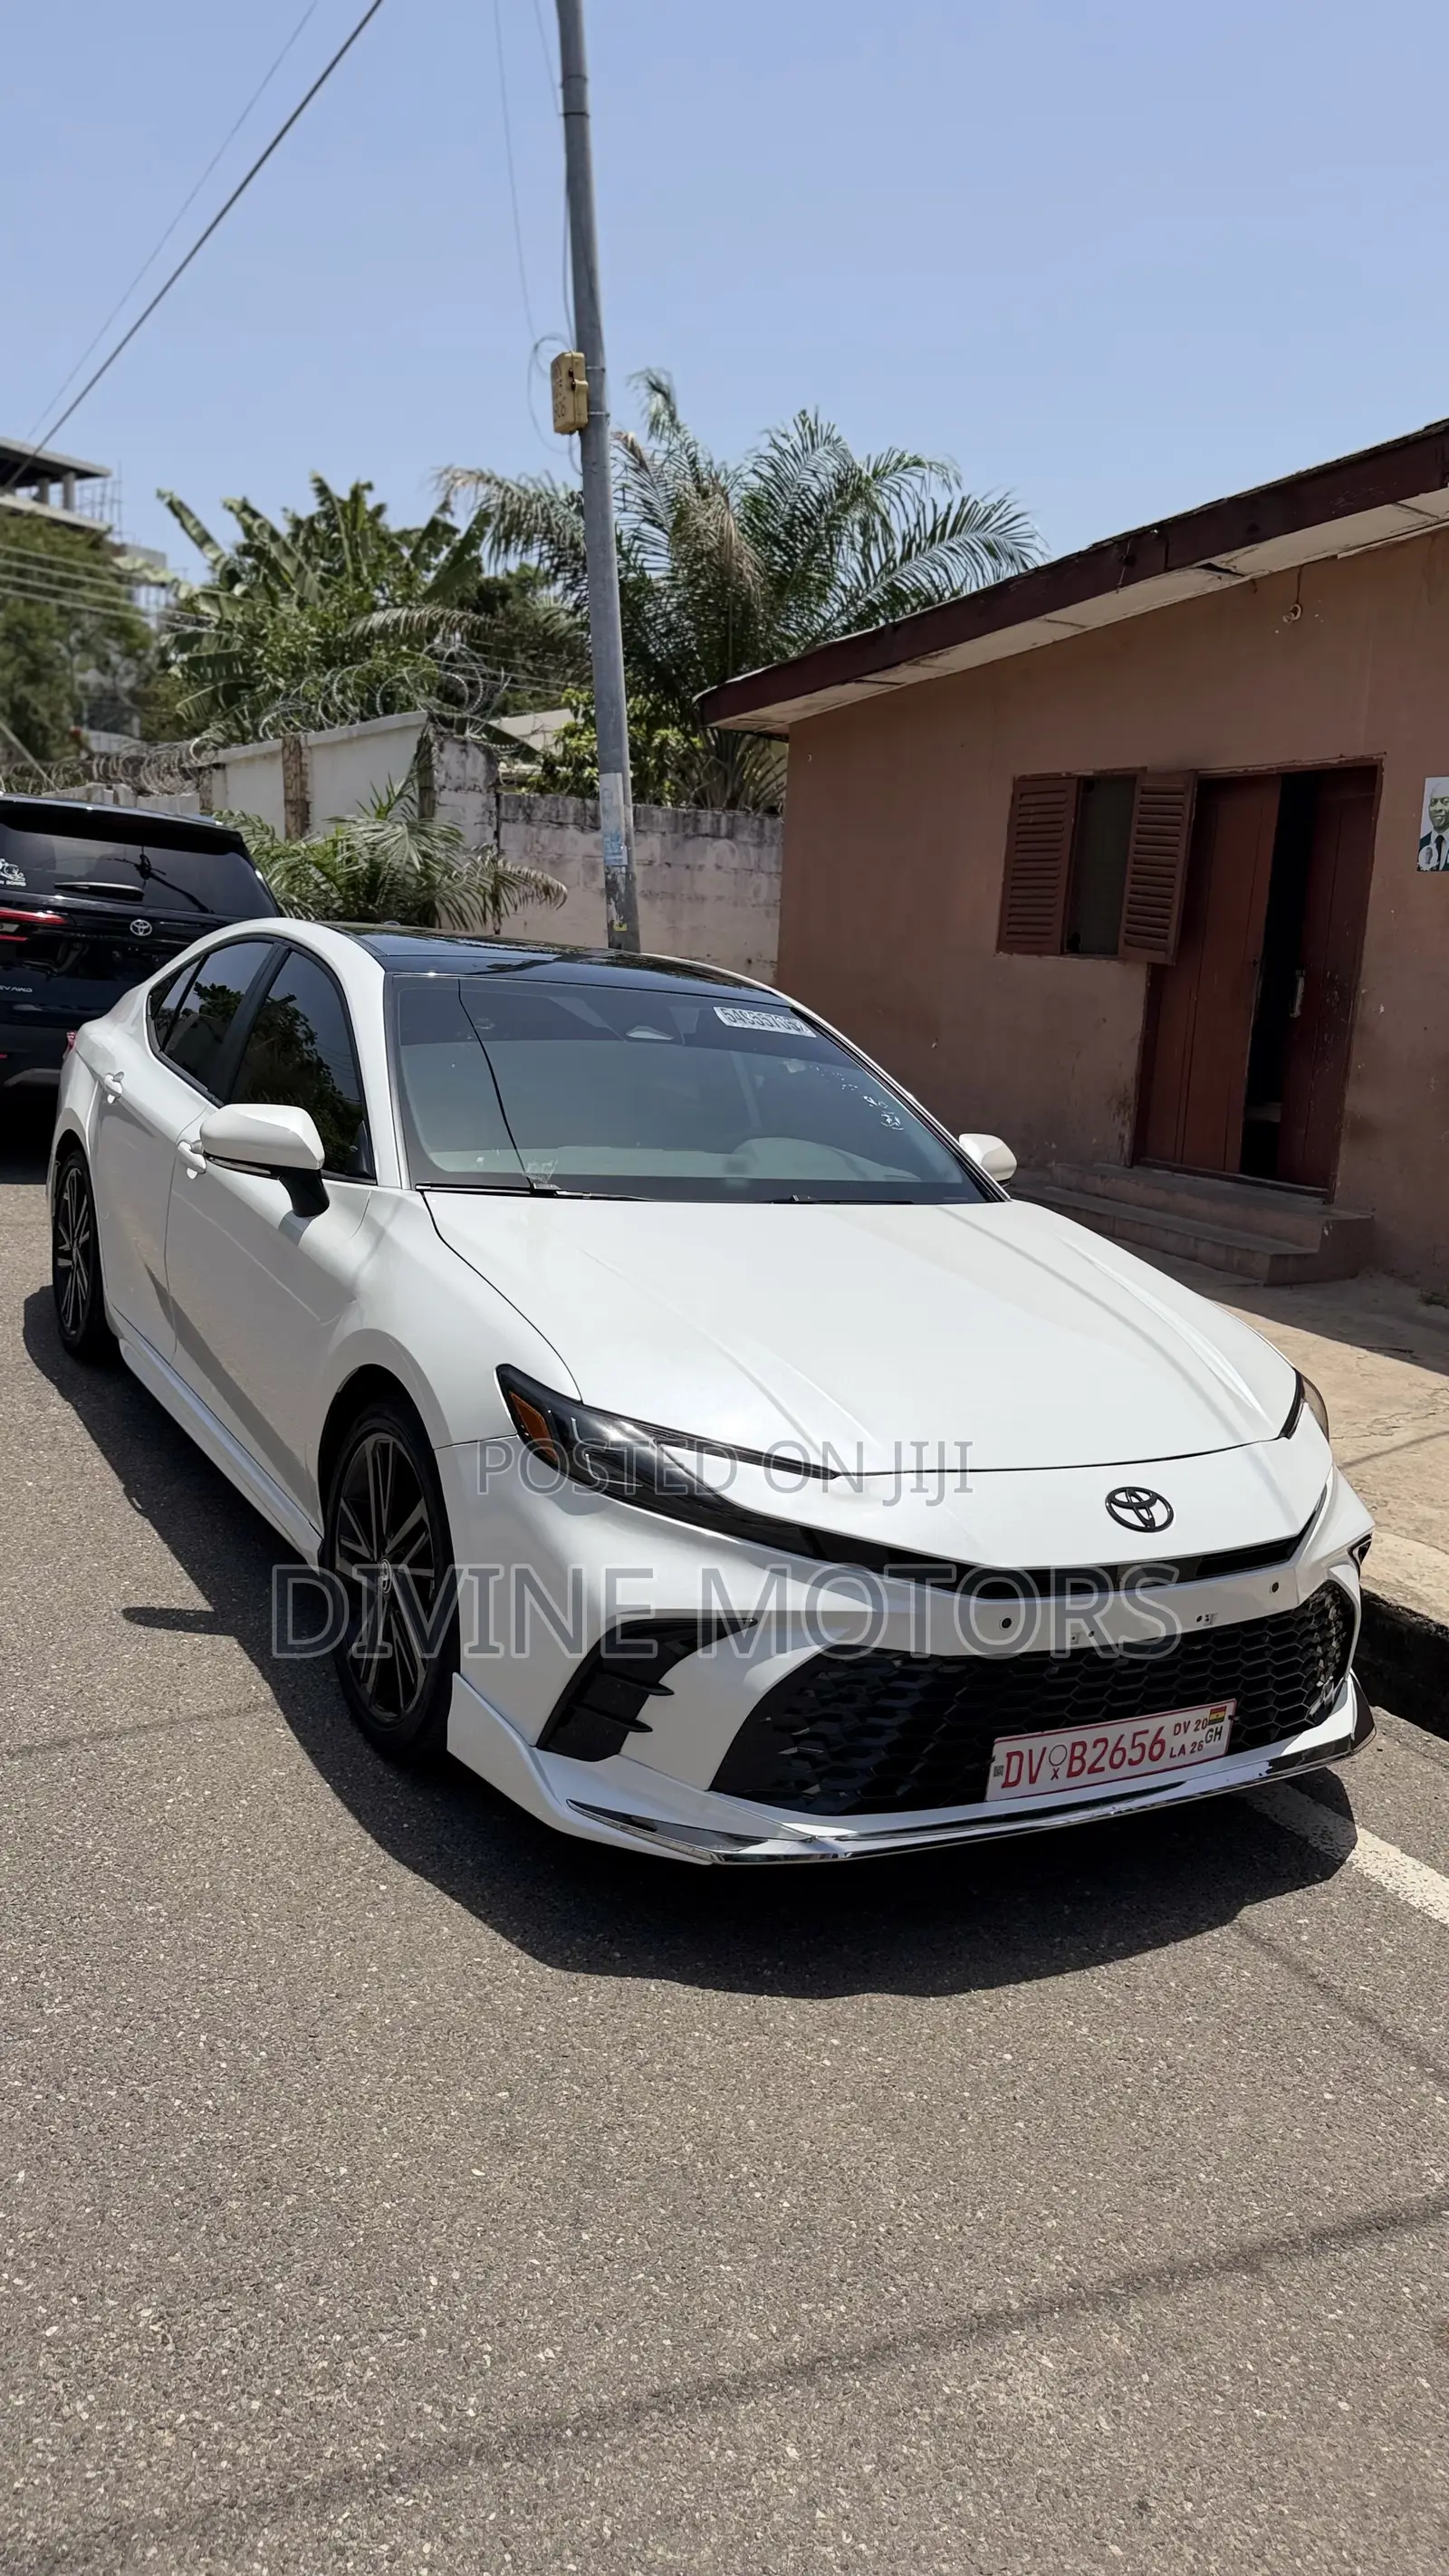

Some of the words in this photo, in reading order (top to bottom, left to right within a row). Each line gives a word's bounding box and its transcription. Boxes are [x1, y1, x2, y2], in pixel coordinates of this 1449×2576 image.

[1173, 1719, 1191, 1737] DV
[1193, 1717, 1208, 1732] 20
[1204, 1725, 1223, 1745] GH
[1001, 1746, 1048, 1789] DV
[1066, 1725, 1166, 1779] B2656
[1169, 1743, 1186, 1758] LA
[1189, 1739, 1204, 1755] 26
